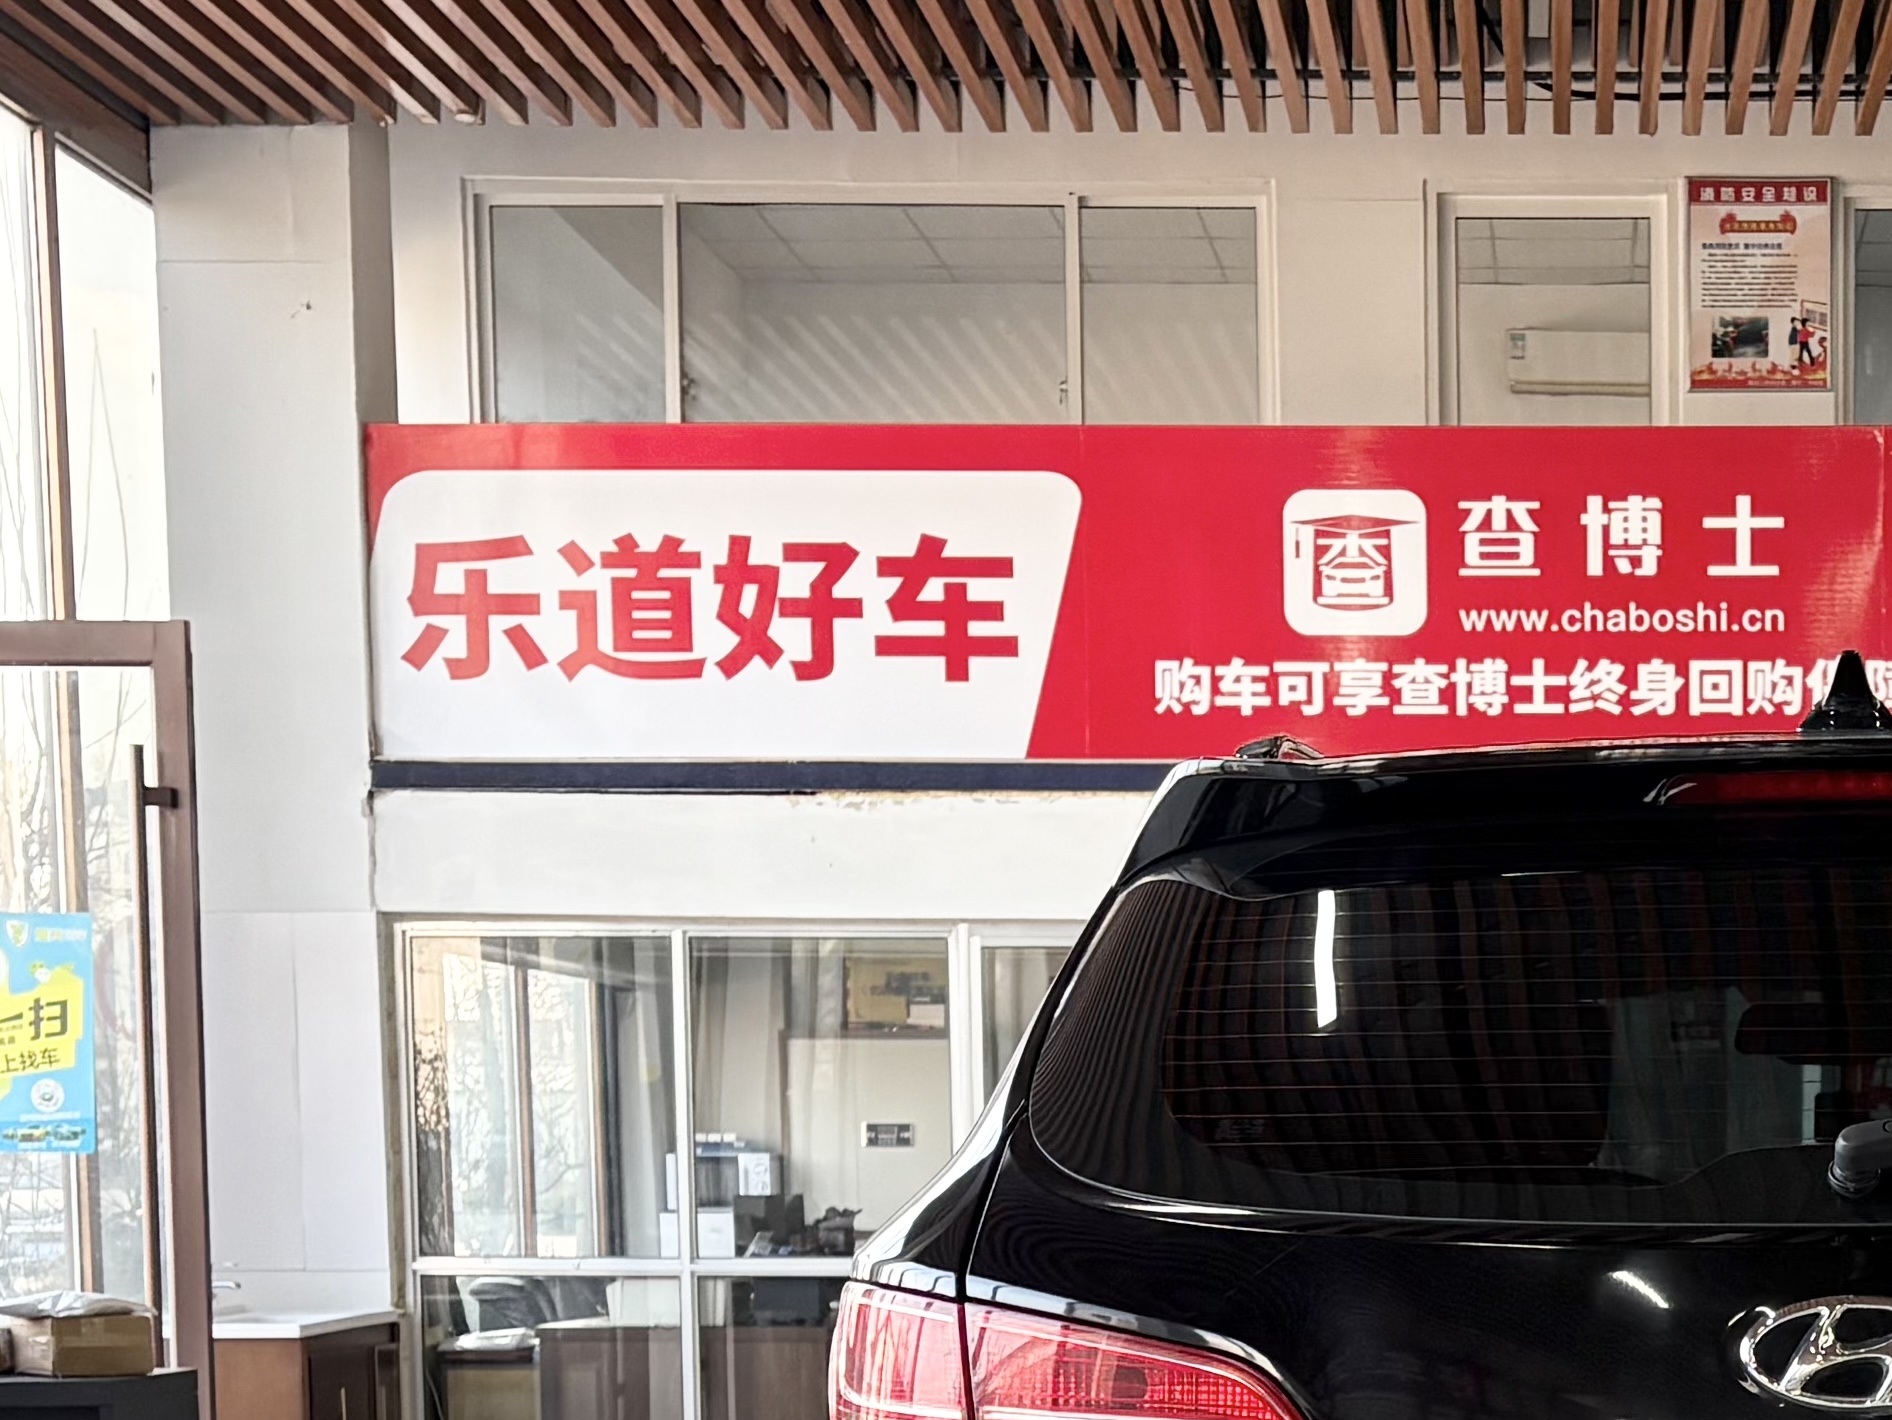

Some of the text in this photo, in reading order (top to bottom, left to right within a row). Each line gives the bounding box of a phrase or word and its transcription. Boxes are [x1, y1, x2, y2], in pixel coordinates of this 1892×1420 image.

[1457, 494, 1786, 577] 查博士
[400, 532, 1019, 683] 乐道好车
[1458, 602, 1786, 634] www.chaboshi.cn
